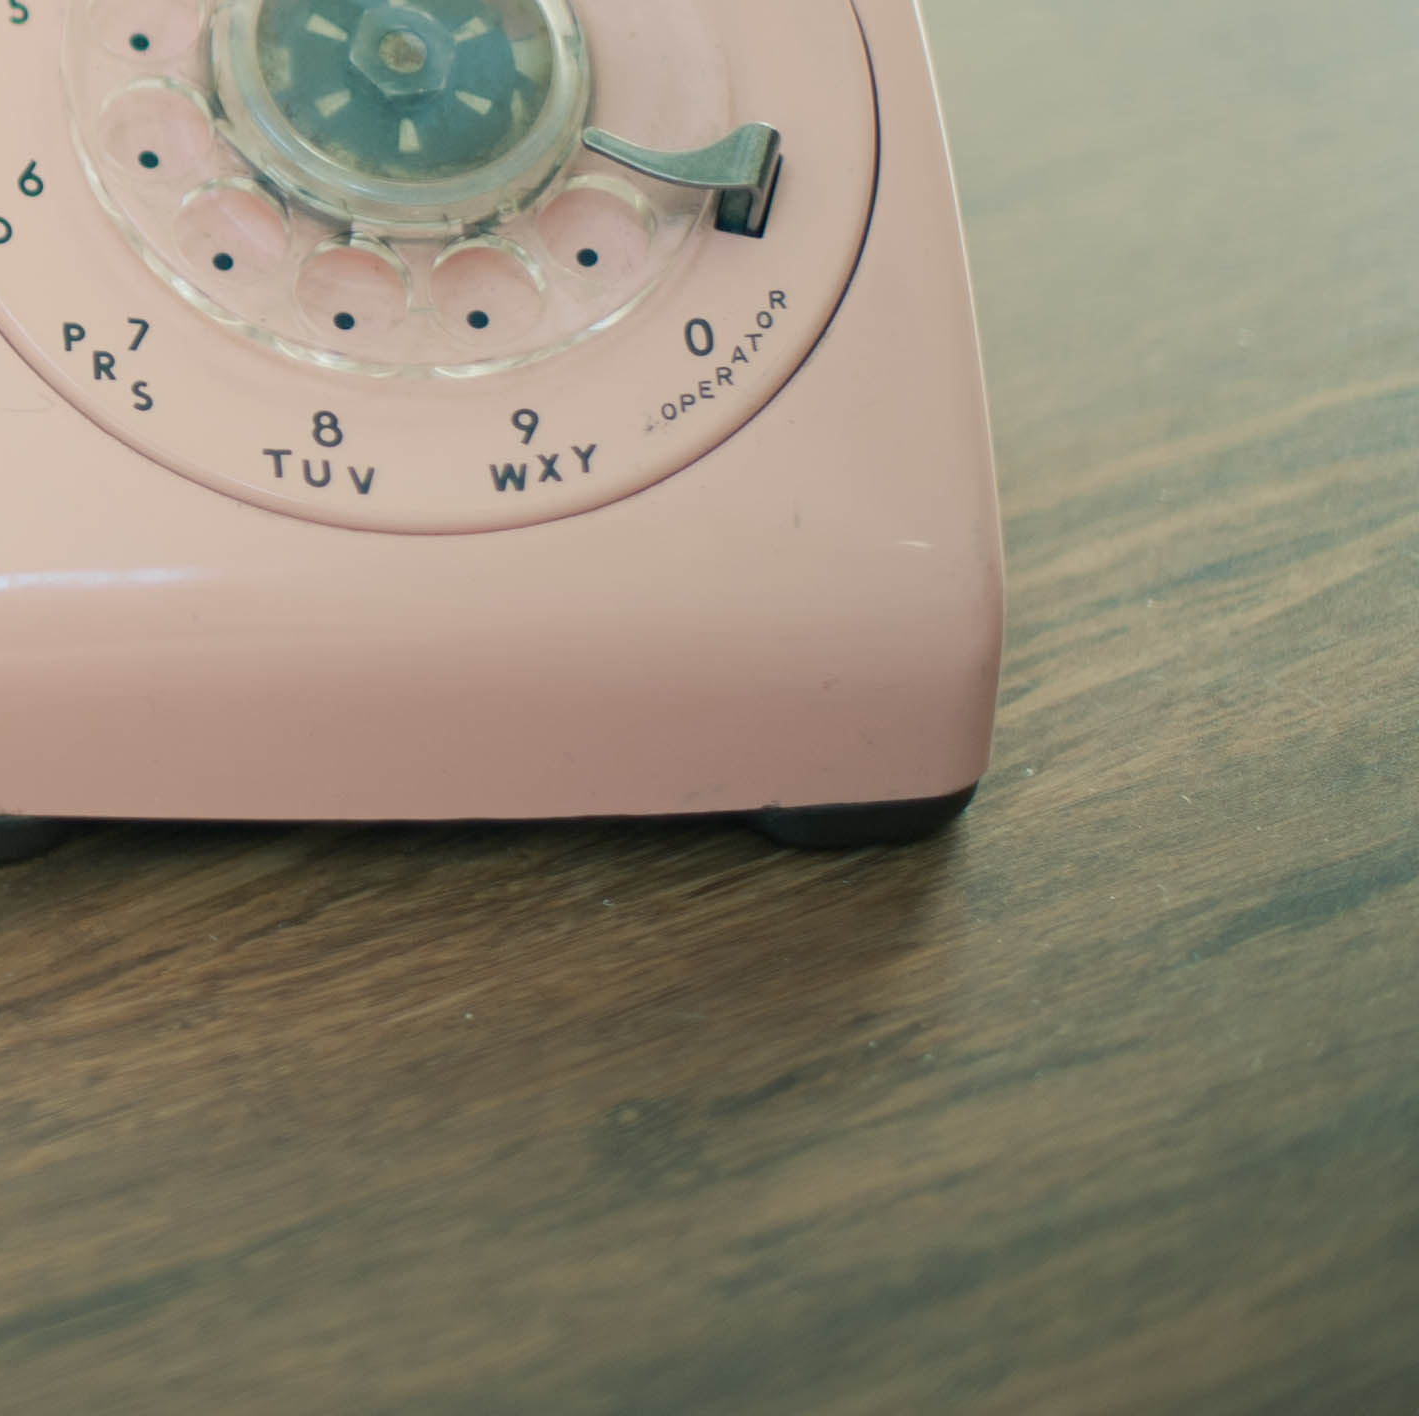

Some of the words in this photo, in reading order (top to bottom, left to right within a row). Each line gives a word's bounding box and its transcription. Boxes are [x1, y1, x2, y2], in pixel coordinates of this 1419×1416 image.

[17, 160, 45, 198] 6
[127, 317, 151, 351] 7
[683, 317, 715, 358] 0
[660, 289, 788, 422] OPERATOR
[311, 410, 344, 449] 8
[510, 408, 540, 446] 9
[262, 448, 376, 496] TUV
[488, 443, 598, 493] WXY
